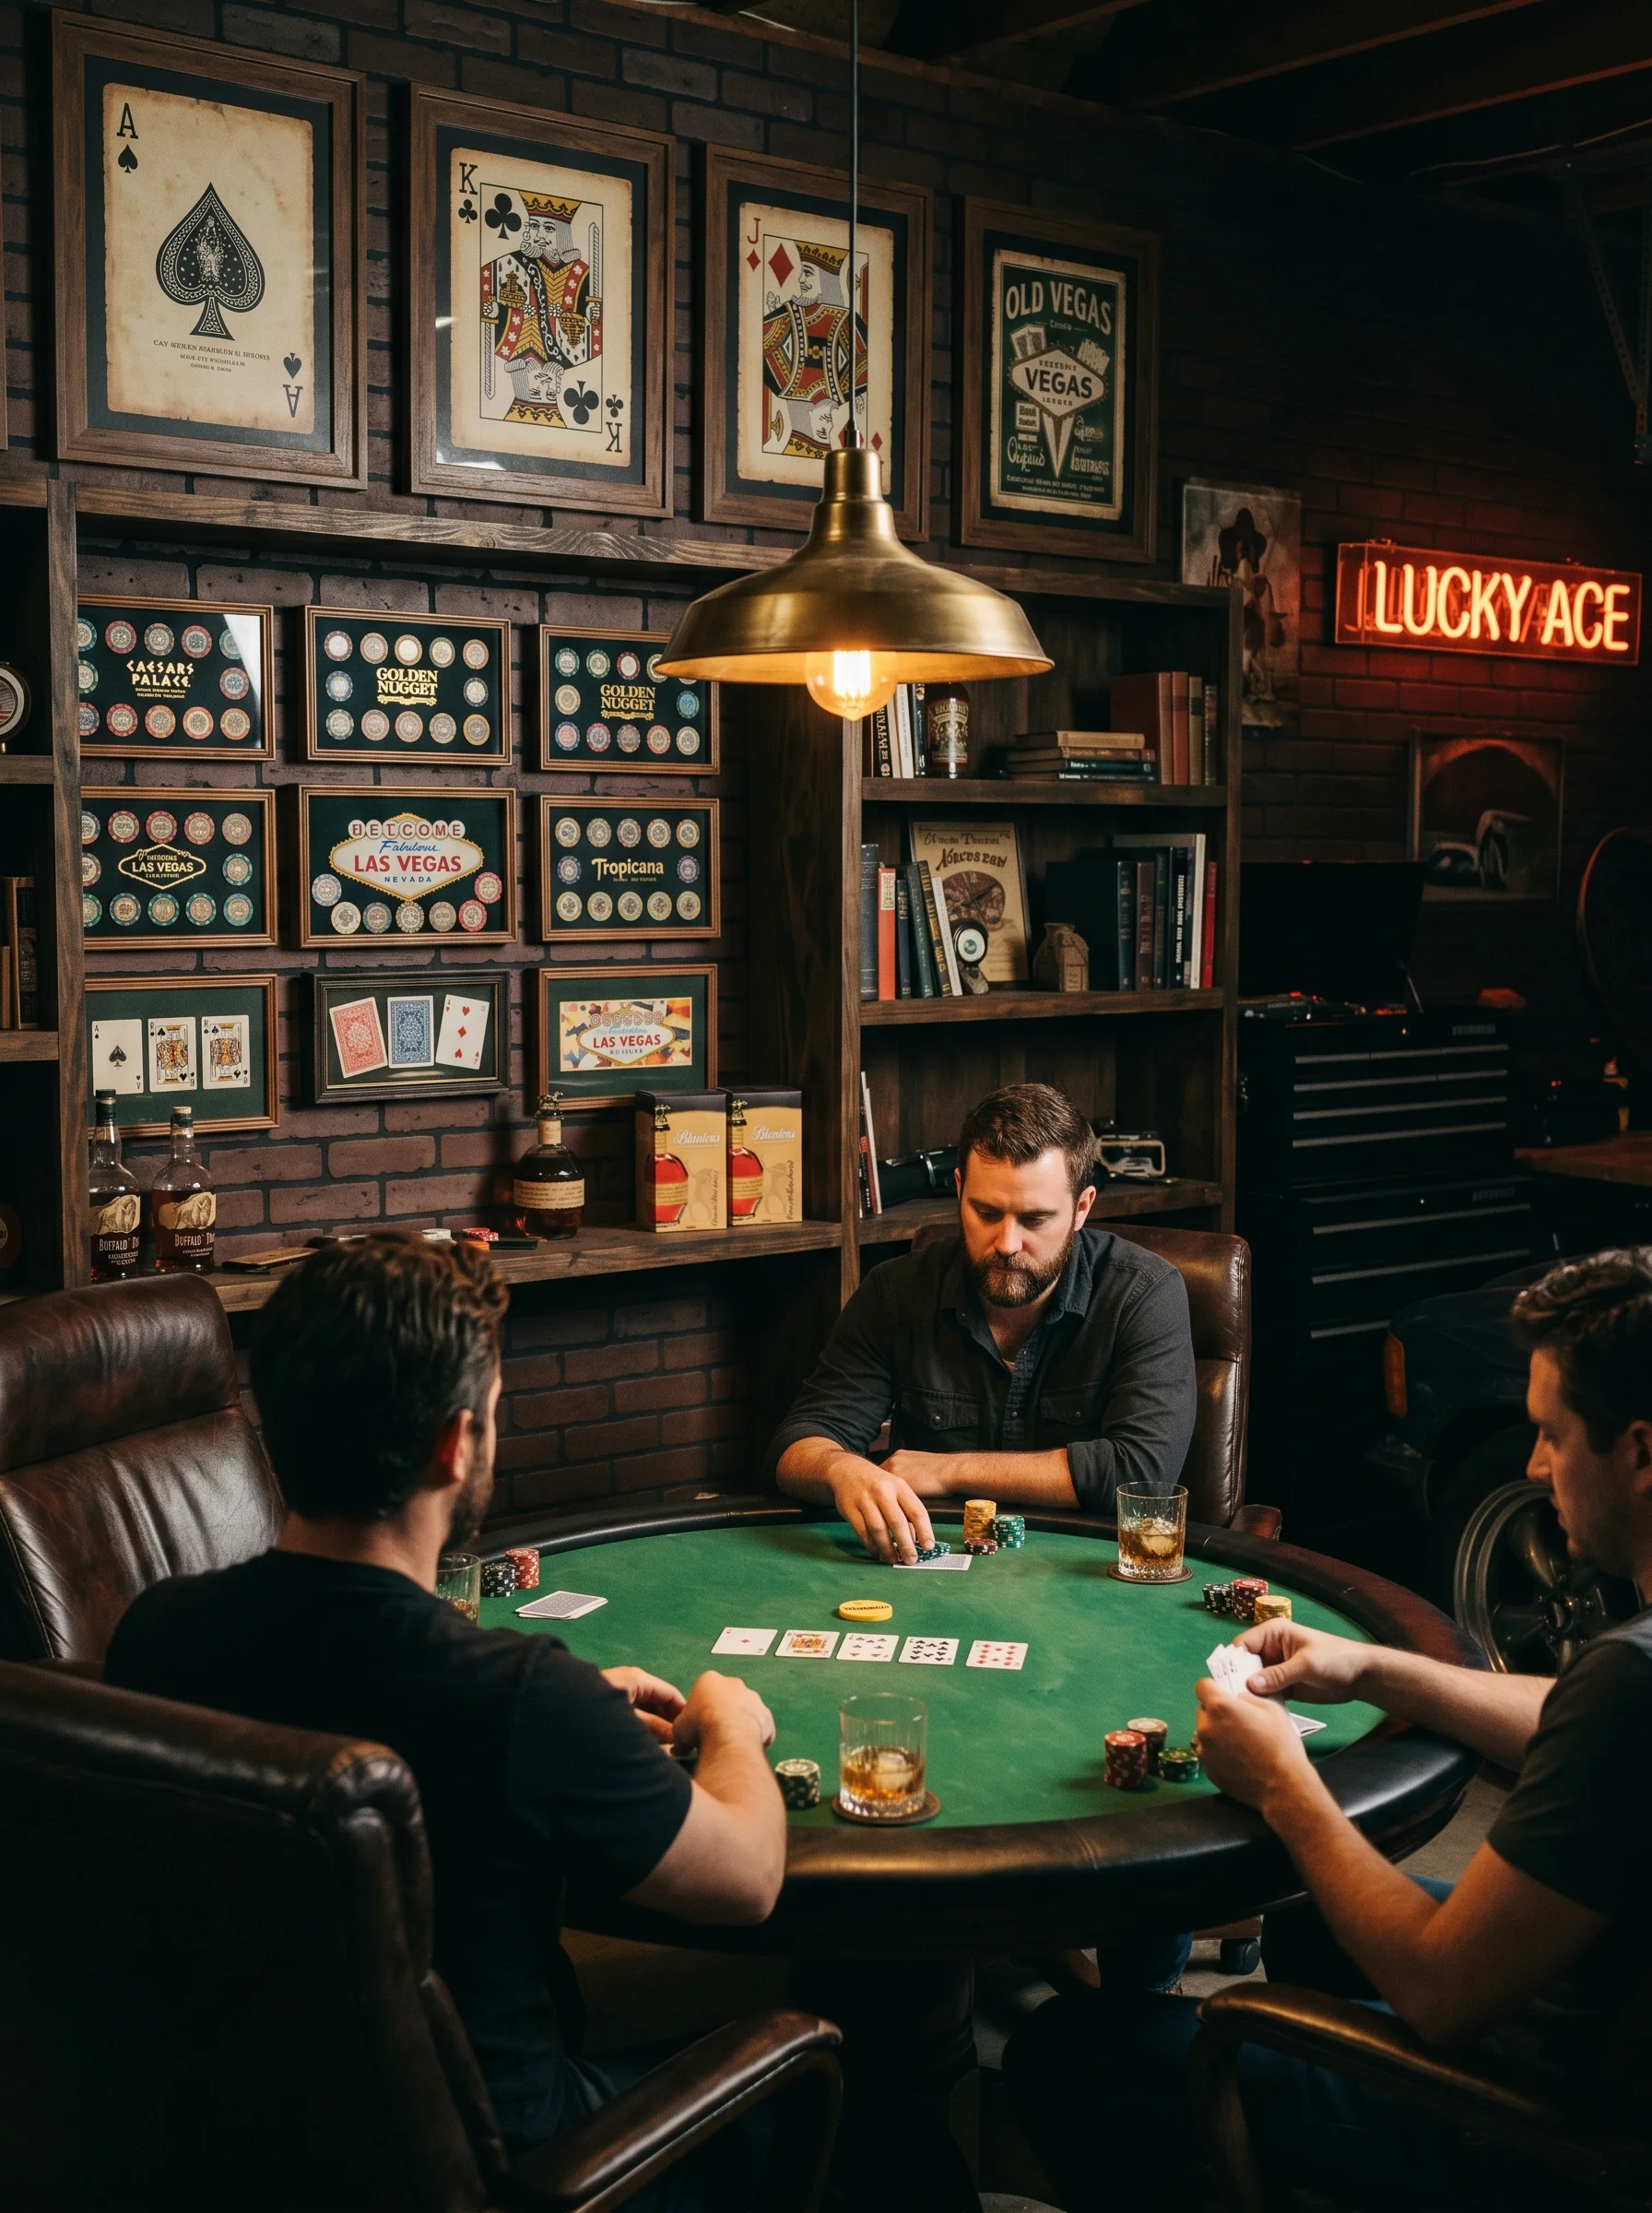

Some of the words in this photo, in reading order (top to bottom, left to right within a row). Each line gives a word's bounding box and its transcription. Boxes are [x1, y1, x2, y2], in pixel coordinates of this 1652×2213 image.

[117, 102, 138, 139] A
[459, 162, 478, 195] K
[747, 217, 761, 244] J
[1006, 281, 1044, 320] OLD
[1050, 281, 1112, 335] VEGAS
[1025, 367, 1092, 398] VEGAS
[282, 384, 303, 418] A
[606, 421, 622, 453] K
[1375, 560, 1532, 642] LUCKY
[1540, 579, 1630, 651] ACE
[126, 659, 195, 675] CAESARS
[376, 668, 438, 682] GOLDEN
[377, 680, 438, 695] NUGGET
[600, 684, 655, 699] GOLDEN
[600, 696, 655, 711] NUGGET
[132, 862, 154, 872] LAS
[157, 862, 194, 872] VEGAS
[354, 855, 390, 872] LAS
[397, 855, 461, 872] VEGAS
[591, 858, 664, 882] Tropicana
[593, 1036, 616, 1048] LAS
[620, 1035, 661, 1047] VEGAS
